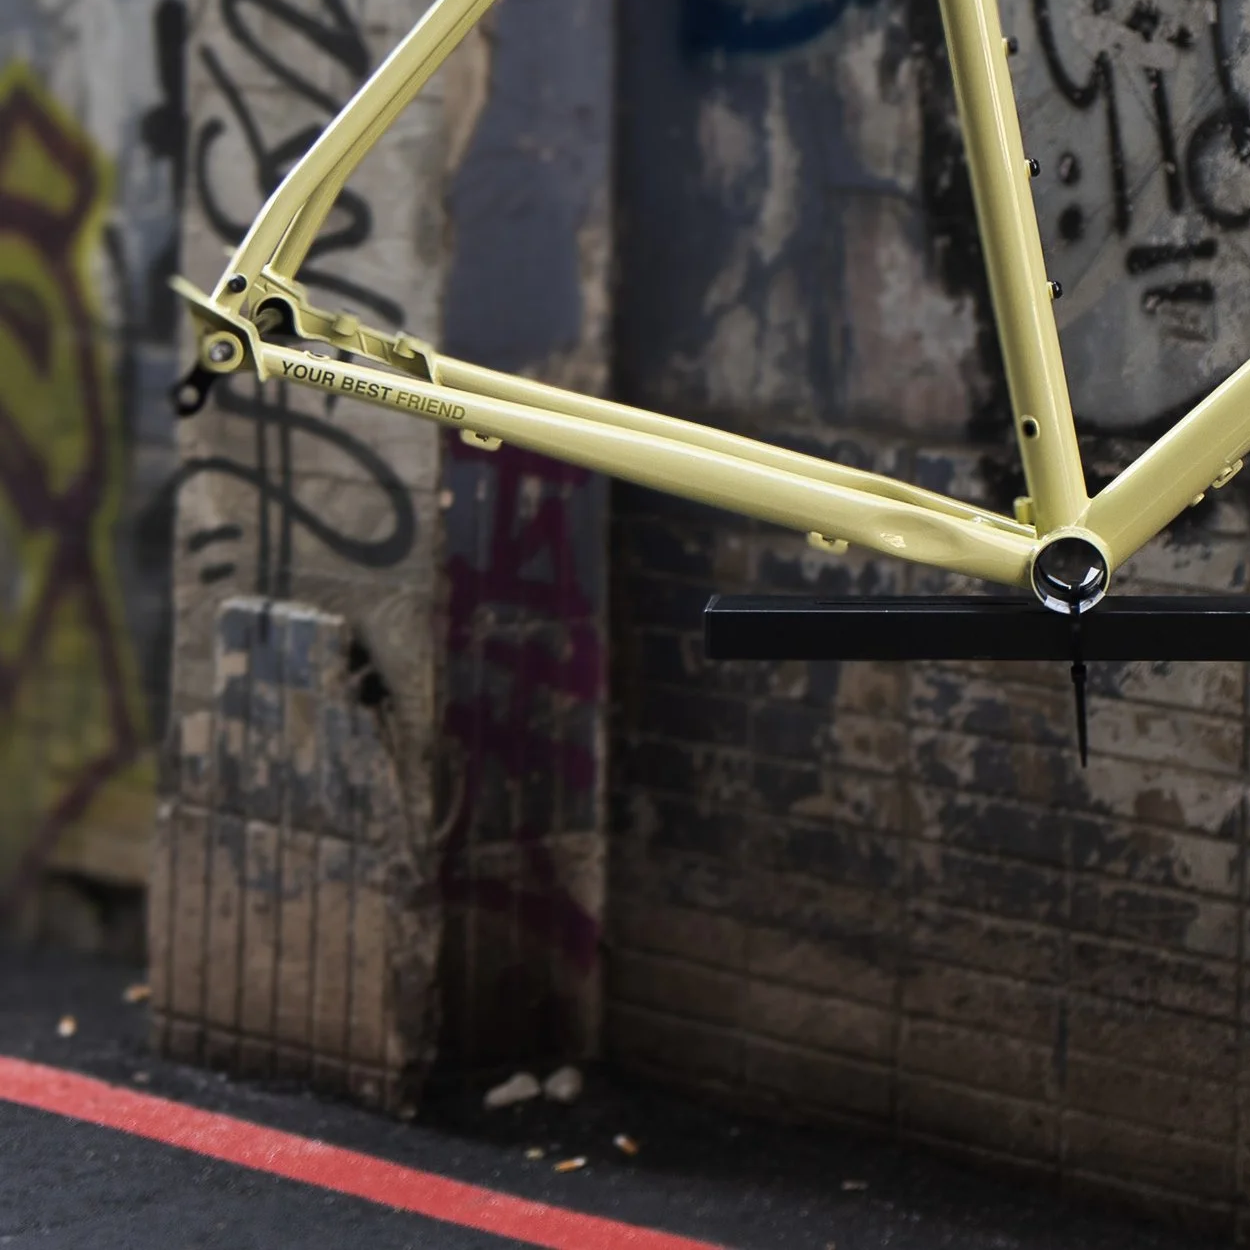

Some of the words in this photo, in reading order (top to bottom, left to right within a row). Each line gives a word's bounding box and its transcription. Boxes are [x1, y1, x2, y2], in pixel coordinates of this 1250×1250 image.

[282, 360, 336, 387] YOUR
[340, 376, 393, 400] BEST
[395, 391, 466, 420] FRIEND
